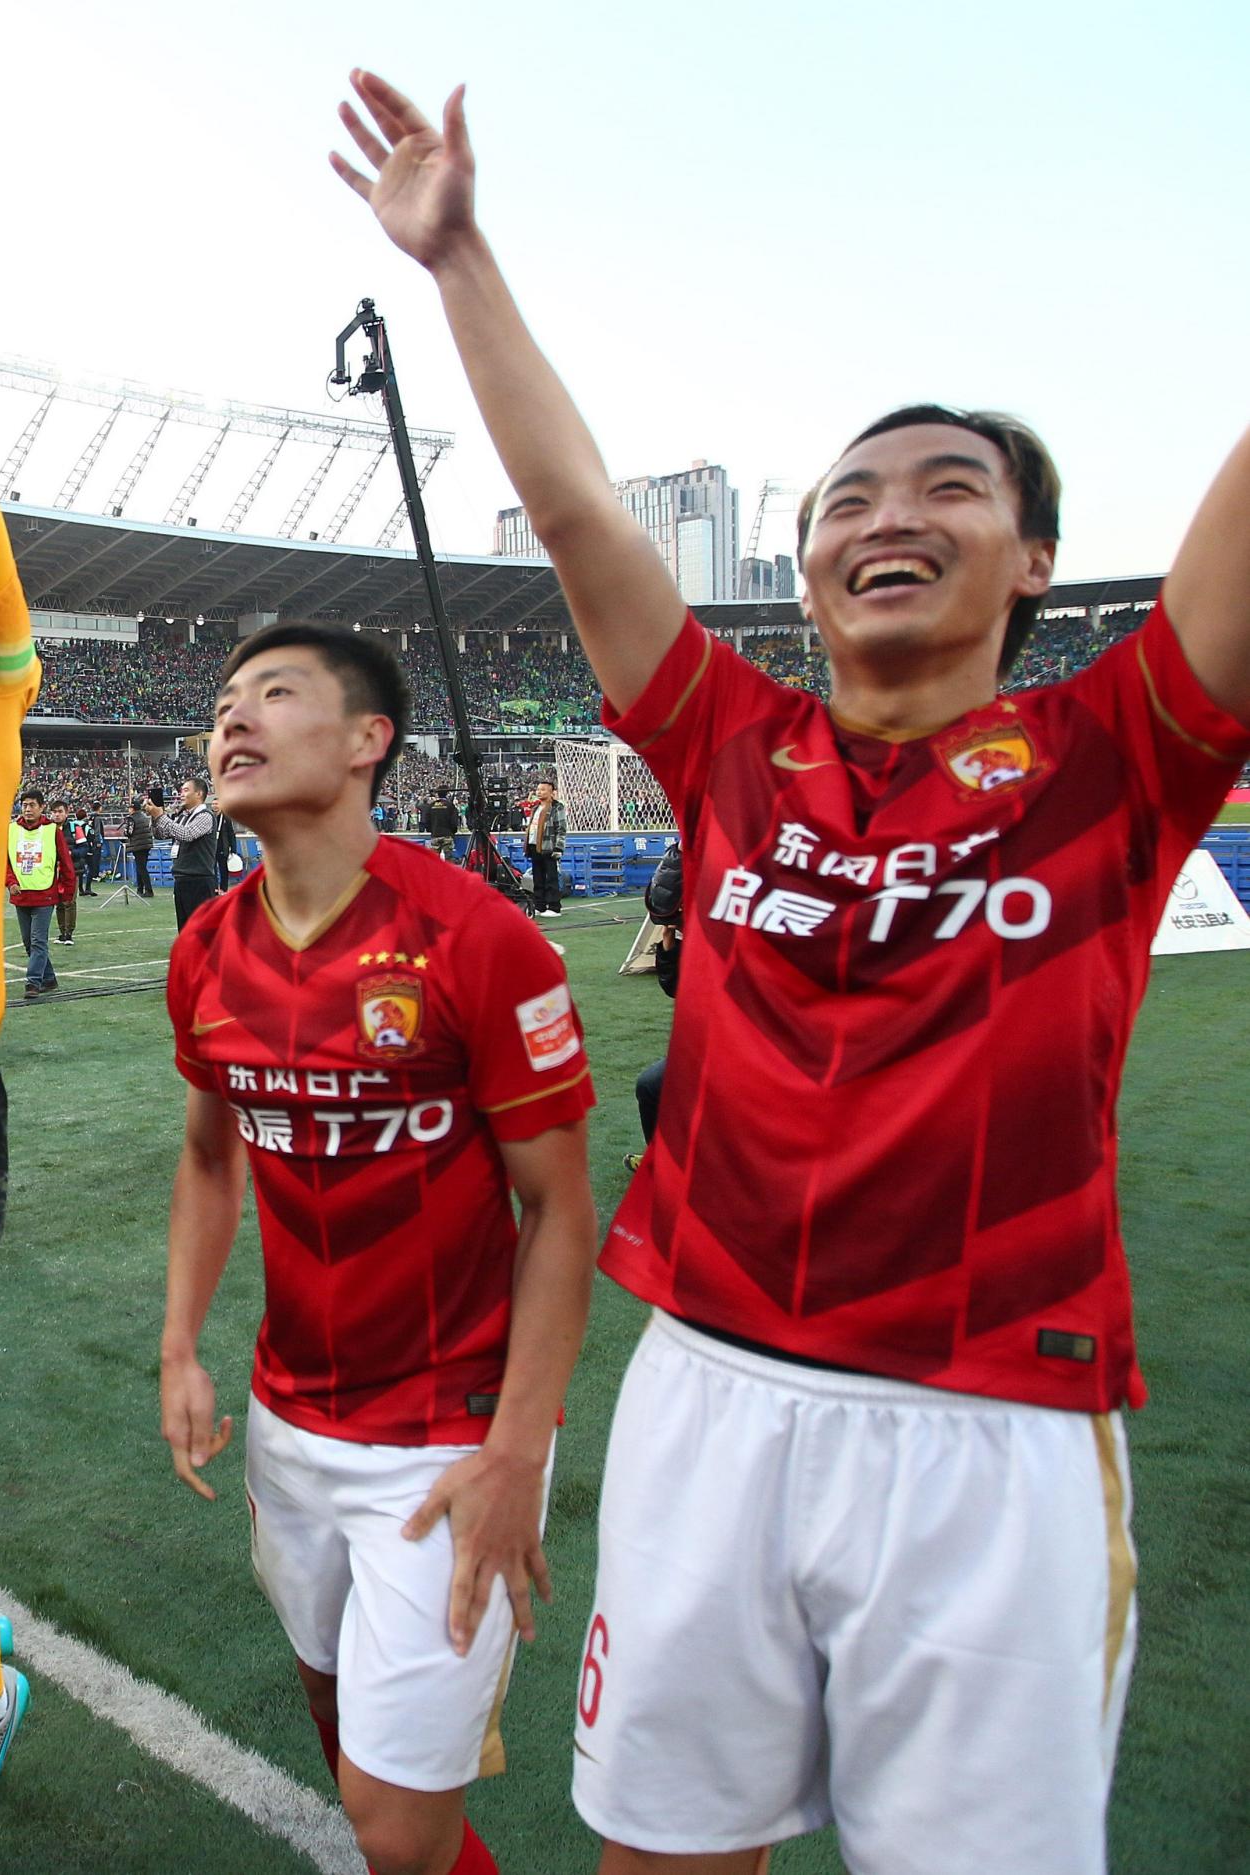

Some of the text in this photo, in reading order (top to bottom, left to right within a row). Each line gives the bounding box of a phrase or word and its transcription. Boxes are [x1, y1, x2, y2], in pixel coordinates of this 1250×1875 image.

[709, 865, 1052, 942] 启辰 T70
[313, 1099, 454, 1156] T70
[579, 1613, 610, 1729] 6
